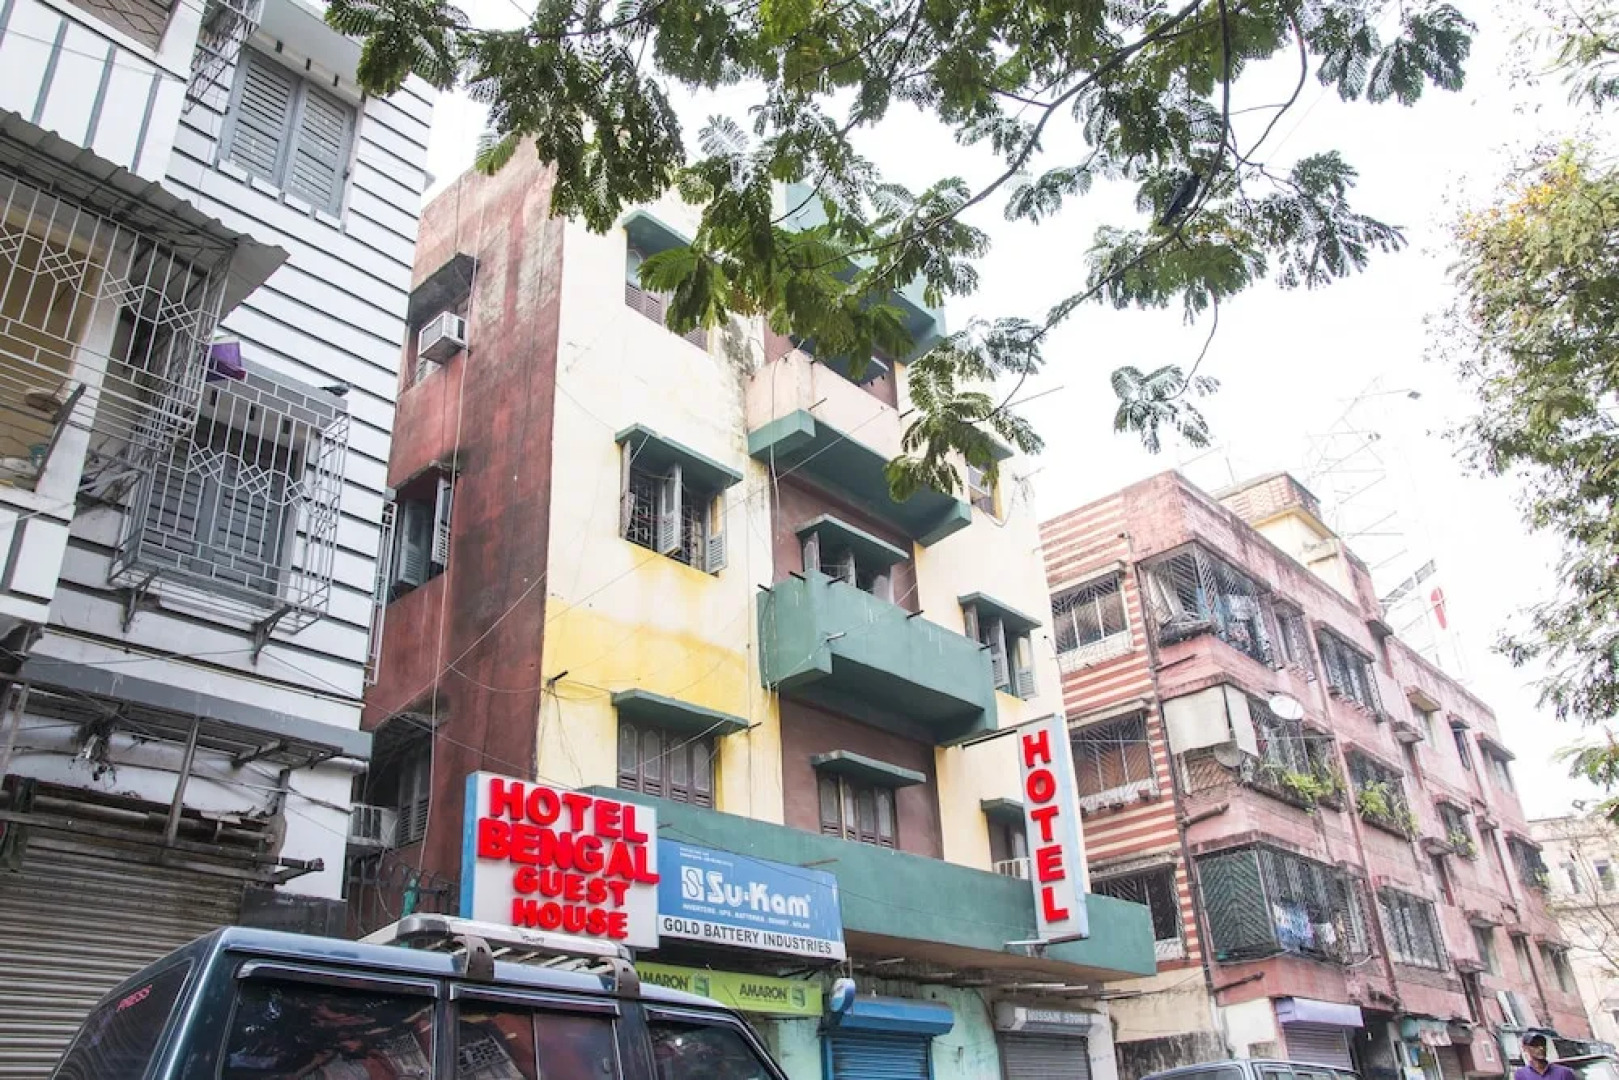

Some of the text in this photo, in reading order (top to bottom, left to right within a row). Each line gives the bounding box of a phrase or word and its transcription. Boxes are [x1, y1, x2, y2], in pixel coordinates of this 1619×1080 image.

[489, 778, 649, 844] HOTEL
[1022, 729, 1070, 924] HOTEL
[478, 817, 660, 885] BENGAL
[513, 865, 631, 908] GUEST
[512, 897, 629, 940] HOUSE
[663, 917, 832, 955] GOLD BATTERY INDUSTRIES
[739, 983, 788, 999] AMARON
